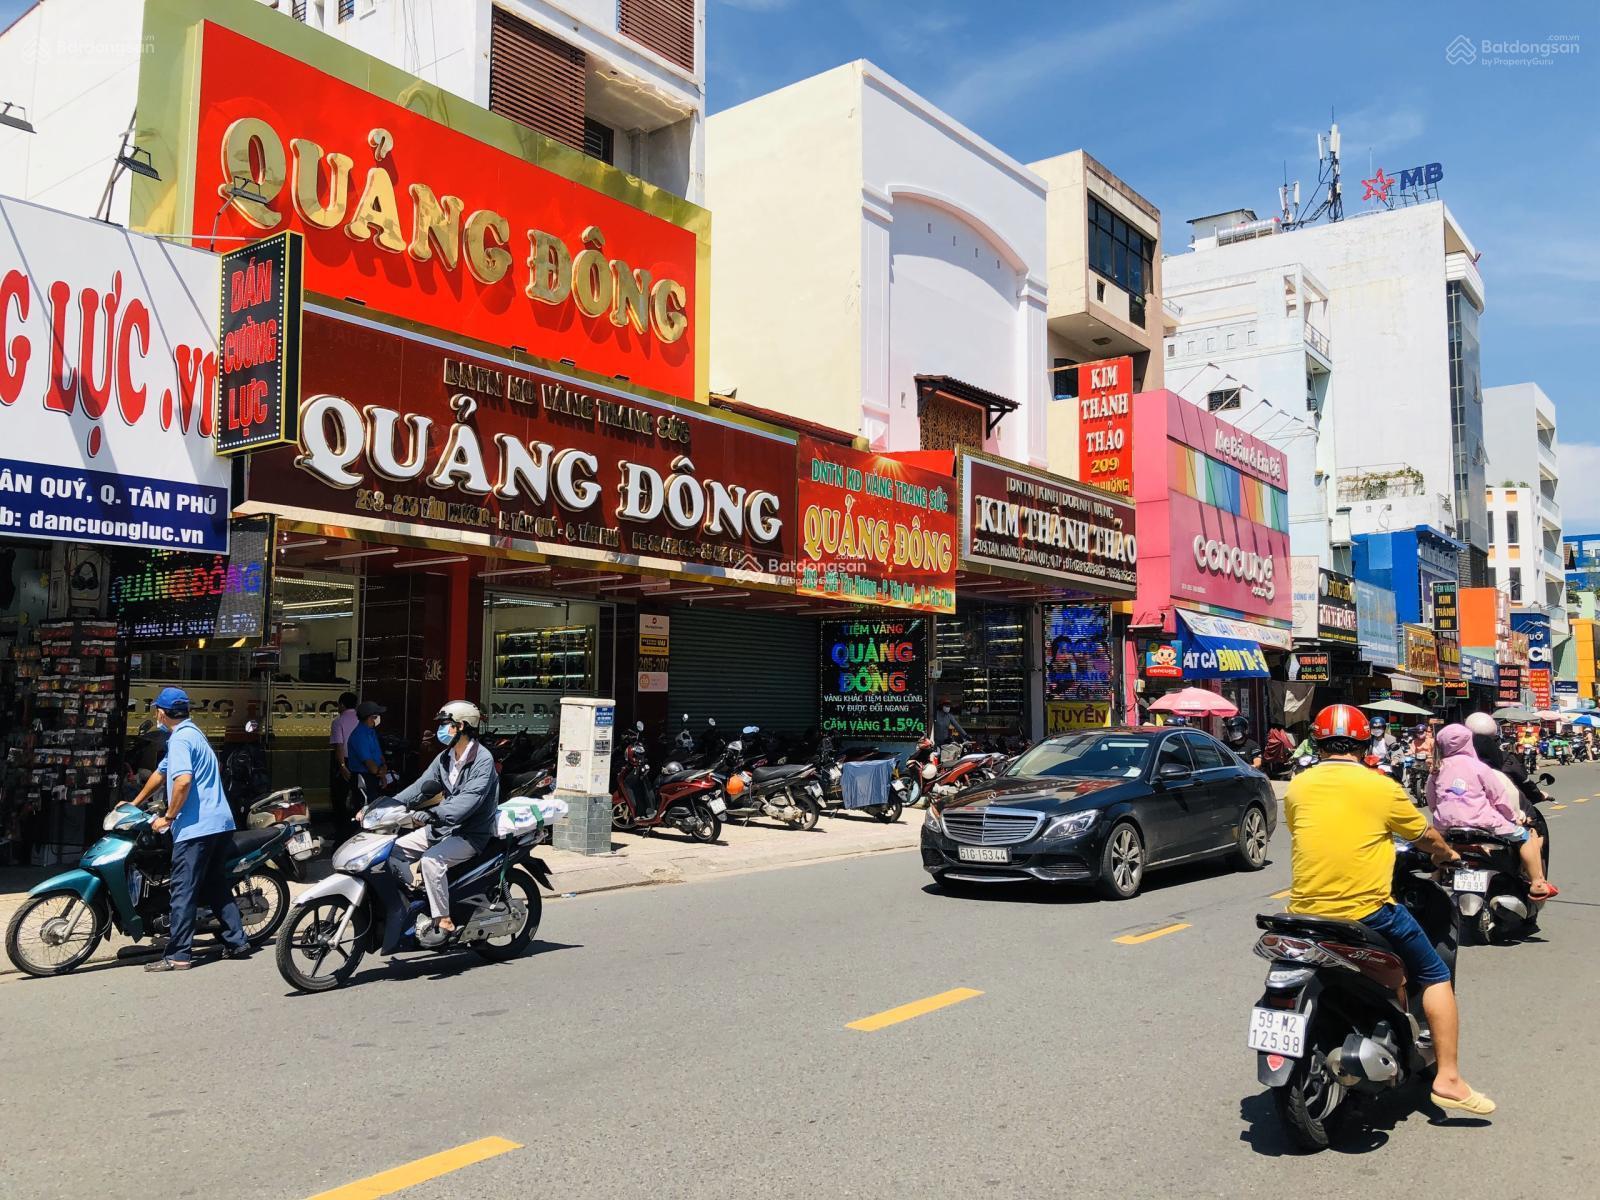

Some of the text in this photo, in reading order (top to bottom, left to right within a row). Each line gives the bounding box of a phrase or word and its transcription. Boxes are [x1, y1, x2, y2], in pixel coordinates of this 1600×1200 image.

[1400, 163, 1443, 190] MB
[218, 117, 687, 344] QUẢNG ĐÔNG
[230, 257, 272, 313] DÁN
[224, 316, 276, 374] CƯỜNG
[44, 270, 150, 458] LỰC
[1091, 364, 1119, 391] KIM
[228, 378, 268, 436] LỰC
[541, 382, 594, 420] VÀNG
[596, 399, 653, 436] TRANG
[656, 414, 690, 443] SỨC
[1086, 421, 1125, 453] THẢO
[294, 393, 783, 544] QUẢNG ĐÔNG
[1091, 457, 1120, 474] 209
[40, 479, 93, 502] QUÝ,
[100, 484, 121, 504] Q.
[129, 487, 170, 510] TÂN
[176, 493, 217, 516] PHÚ
[812, 458, 948, 513] DNTN KD VÀNG TRANG SỨC
[420, 495, 446, 520] TÂN
[975, 495, 1019, 538] KIM
[29, 509, 204, 545] dancuongluc.vn
[803, 494, 891, 565] QUẢNG
[893, 515, 953, 574] ĐÔNG
[843, 621, 904, 637] TIỆM VÀNG
[831, 637, 914, 668] QUẢNG
[838, 665, 907, 693] ĐÔNG
[849, 717, 880, 731] VÀNG
[882, 717, 925, 732] 1.5%
[884, 704, 909, 712] NGANG
[1051, 704, 1107, 724] TUYỂN
[1252, 1029, 1300, 1054] 125.98
